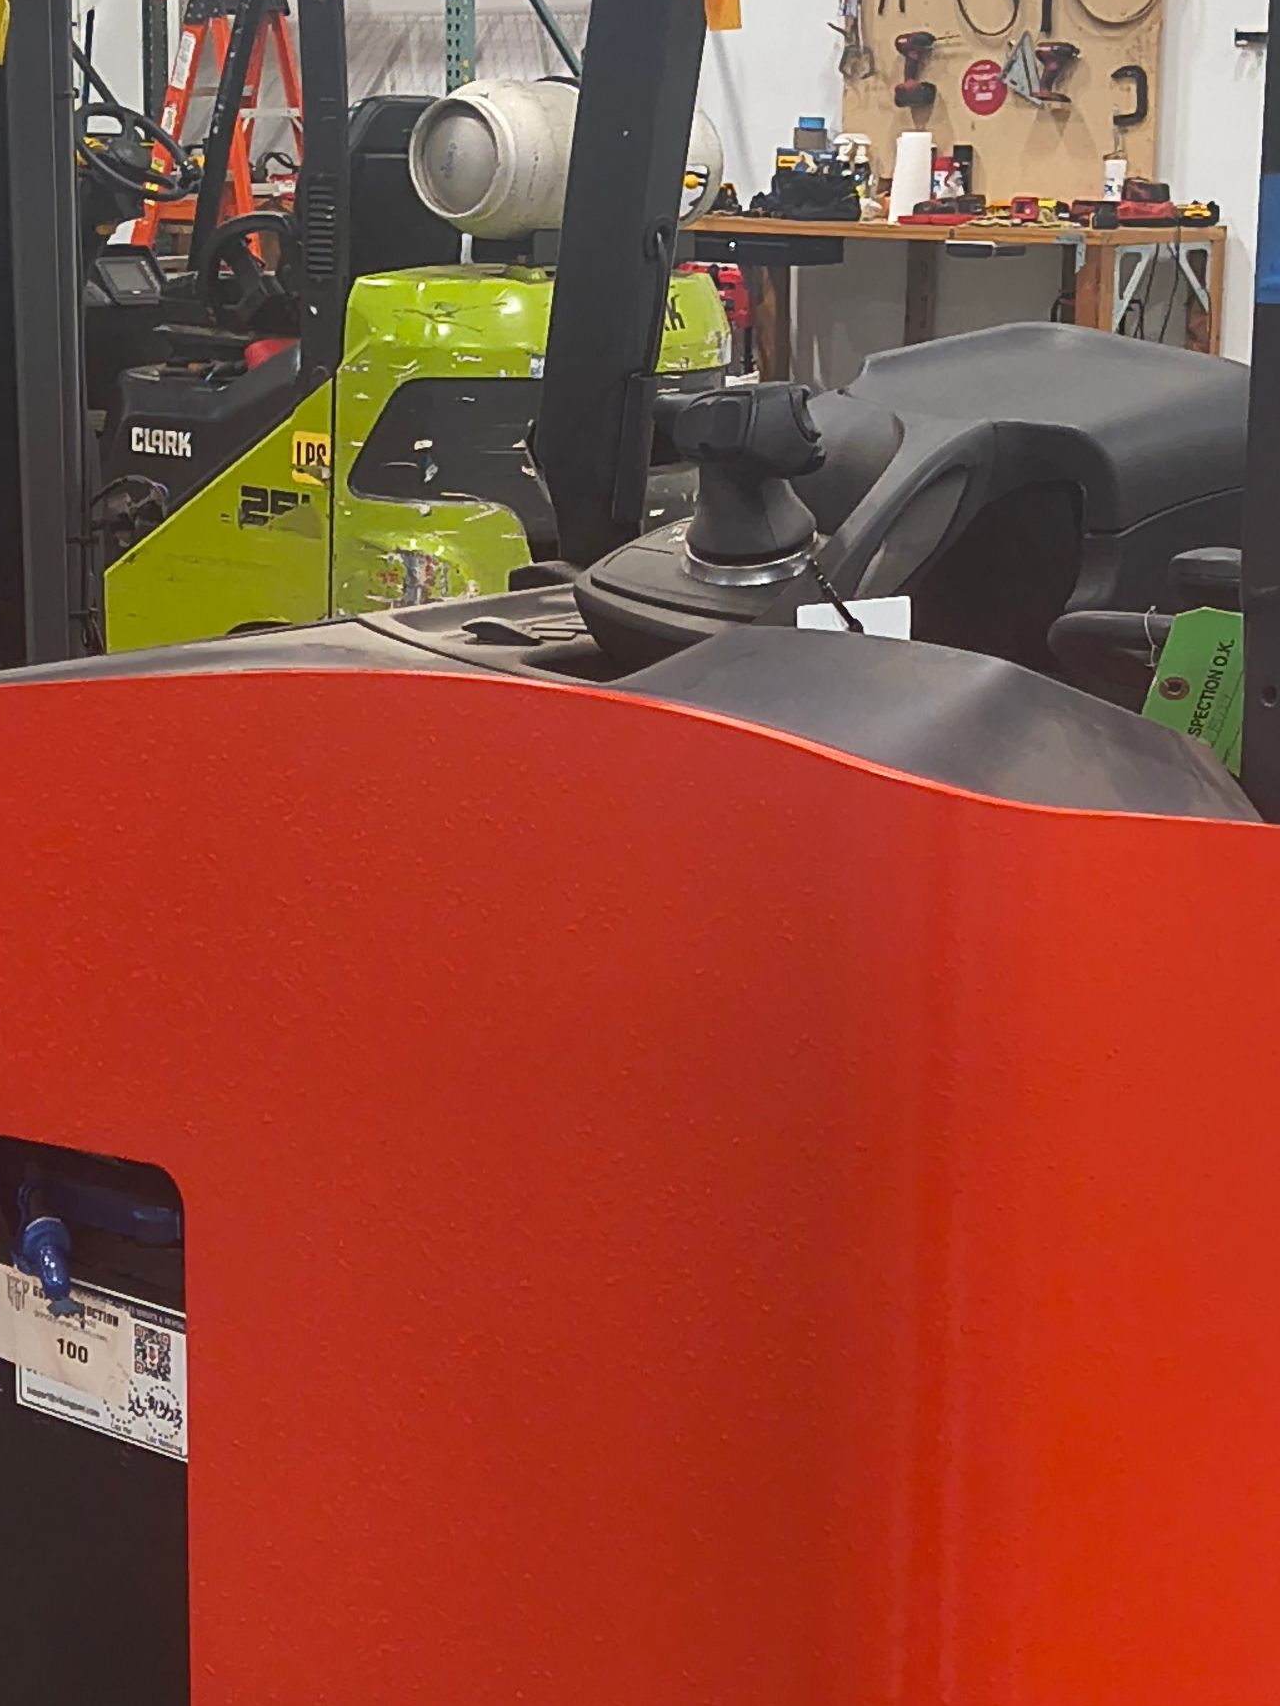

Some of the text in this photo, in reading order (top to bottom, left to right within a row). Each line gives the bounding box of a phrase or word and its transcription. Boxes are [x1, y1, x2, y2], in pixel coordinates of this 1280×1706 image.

[131, 426, 192, 458] CLARK
[1187, 669, 1224, 738] SPECTION
[1212, 638, 1236, 667] O.K.
[56, 1337, 89, 1364] 100
